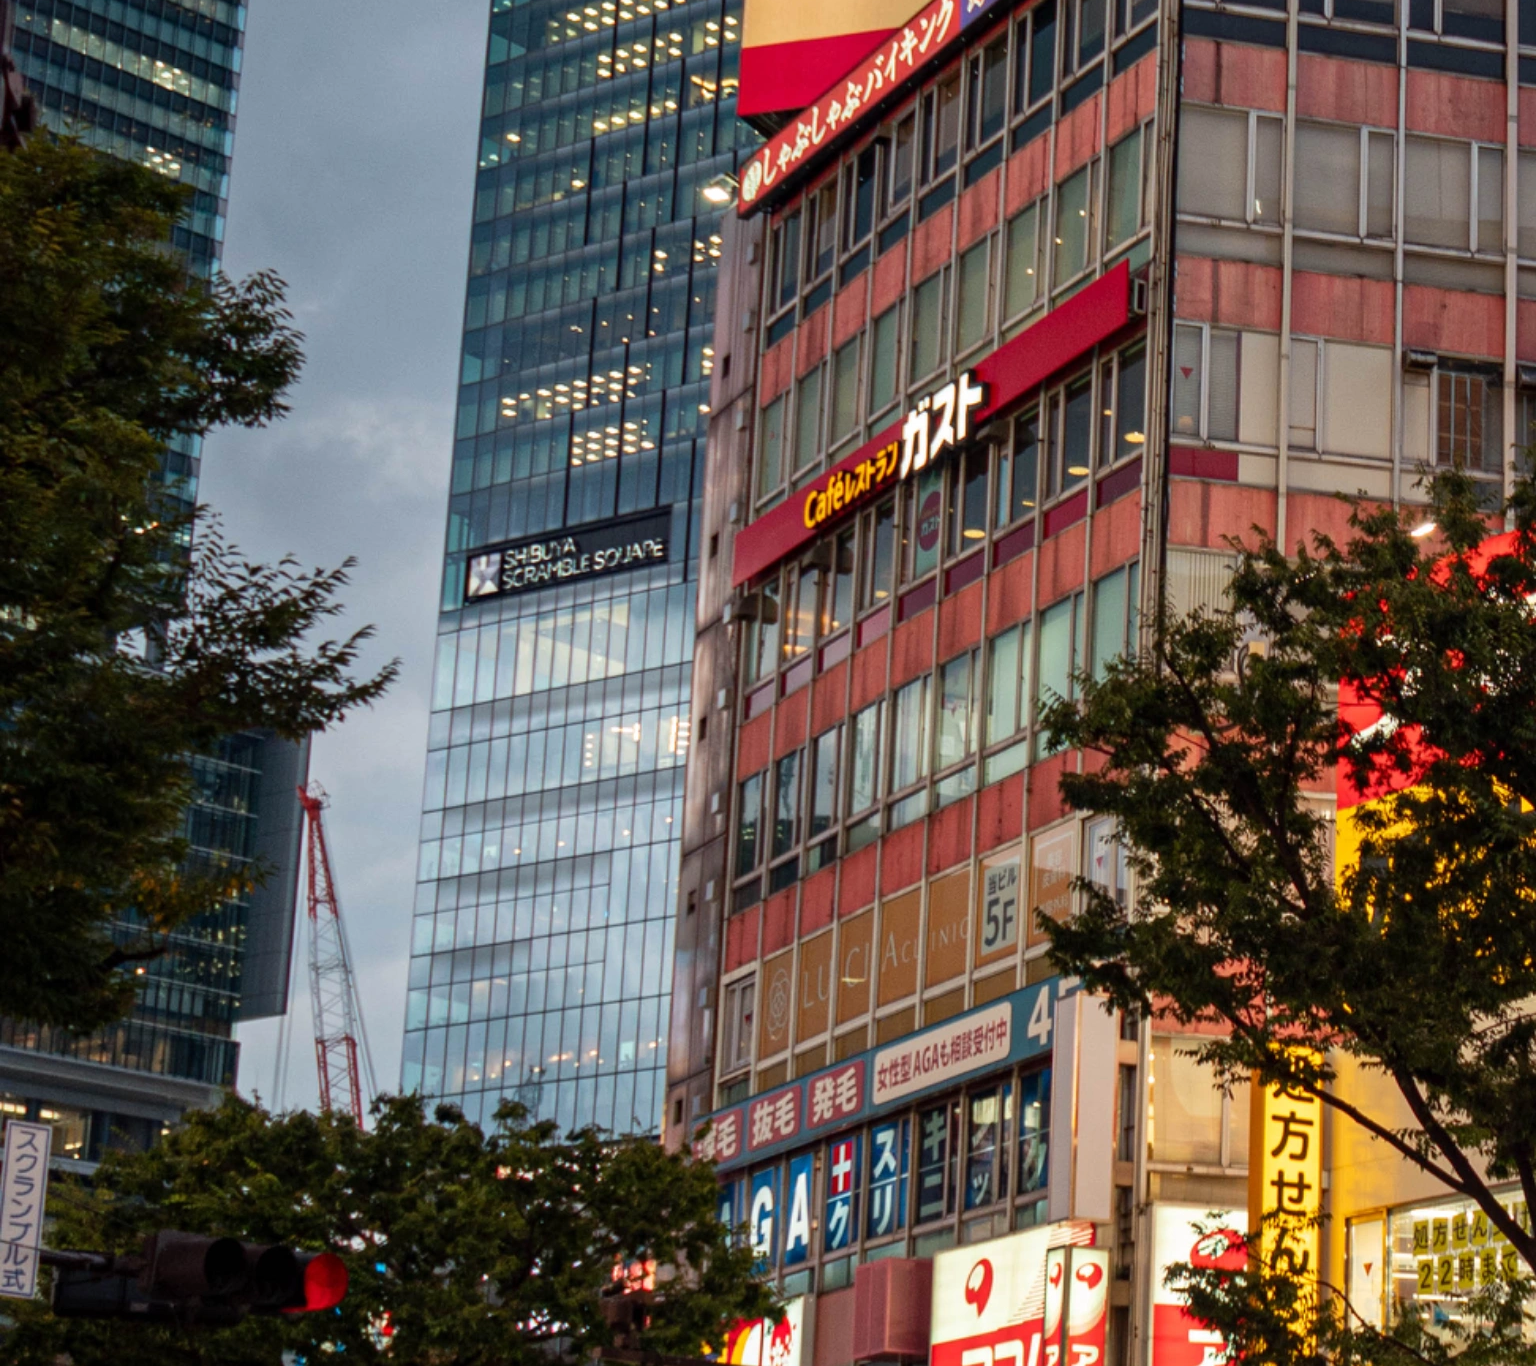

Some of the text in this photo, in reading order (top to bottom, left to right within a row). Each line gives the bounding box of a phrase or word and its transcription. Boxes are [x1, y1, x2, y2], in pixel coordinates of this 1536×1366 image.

[899, 371, 984, 479] ガスト
[803, 439, 900, 529] Caféレストラン
[501, 537, 665, 590] SCRAMBLE SQUARE
[502, 535, 577, 571] SHIBUYA
[987, 866, 1018, 896] 当ビル
[983, 896, 1016, 948] 5F
[876, 1015, 1008, 1094] 女性型AGAも相談受付中
[751, 1091, 797, 1148] 抜毛
[811, 1066, 859, 1123] 発毛
[3, 1129, 39, 1292] スクランブル式
